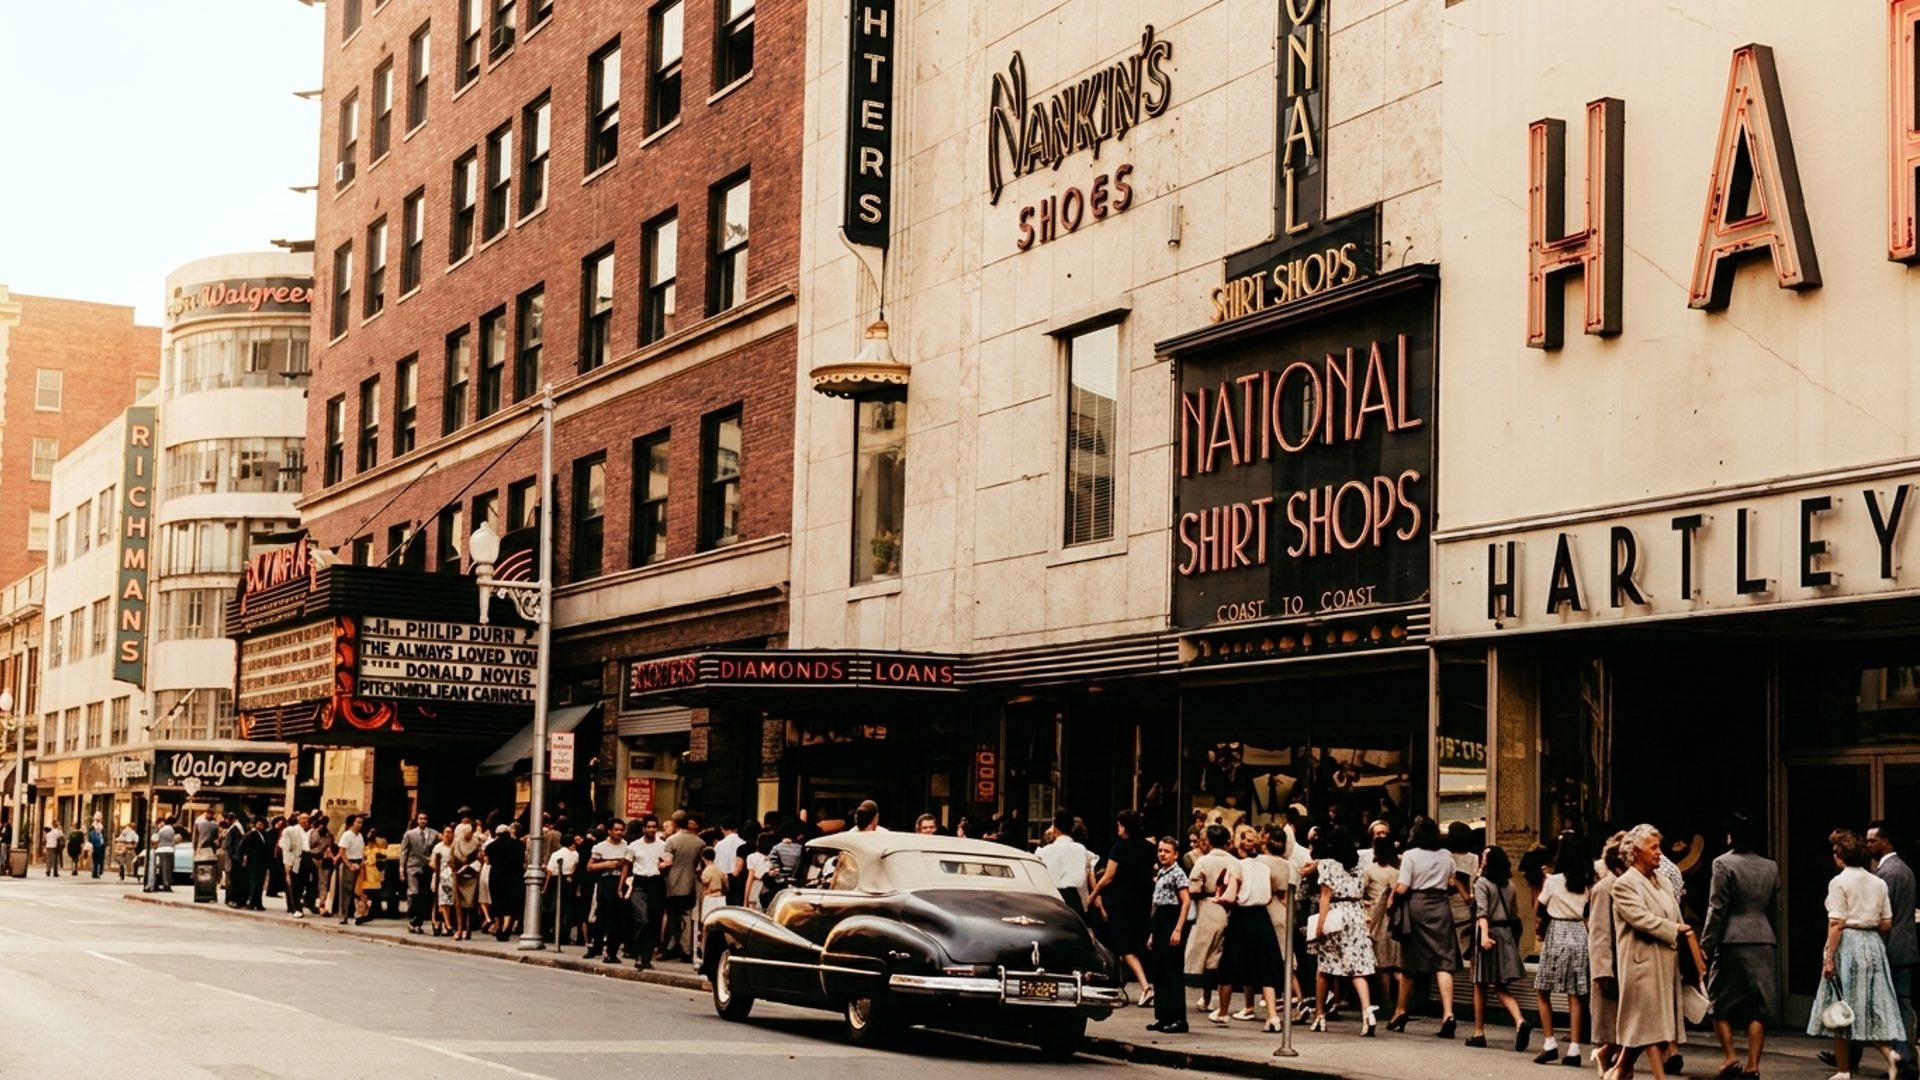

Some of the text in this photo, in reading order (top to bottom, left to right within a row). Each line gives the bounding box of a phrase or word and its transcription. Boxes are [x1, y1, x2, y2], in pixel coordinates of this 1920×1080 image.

[859, 6, 888, 225] HTERS
[988, 24, 1172, 206] NANKIN'S
[1016, 164, 1133, 250] SHOES
[1527, 0, 1920, 351] HA
[1210, 242, 1357, 324] SHIRT SHOPS
[1181, 334, 1423, 477] NATIONAL
[120, 425, 150, 662] RICHMANS
[1178, 469, 1422, 576] SHIRT SHOPS
[1487, 484, 1915, 620] HARTLEY
[406, 622, 463, 641] PHILIP
[1217, 585, 1377, 623] COAST TO COAST
[395, 642, 453, 659] ALWAYS
[458, 646, 505, 664] LOVED
[406, 663, 474, 681] DONALD
[480, 667, 532, 685] NOVIS
[720, 660, 844, 680] DIAMONDS
[875, 661, 954, 684] LOANS
[170, 752, 289, 786] Walgreen
